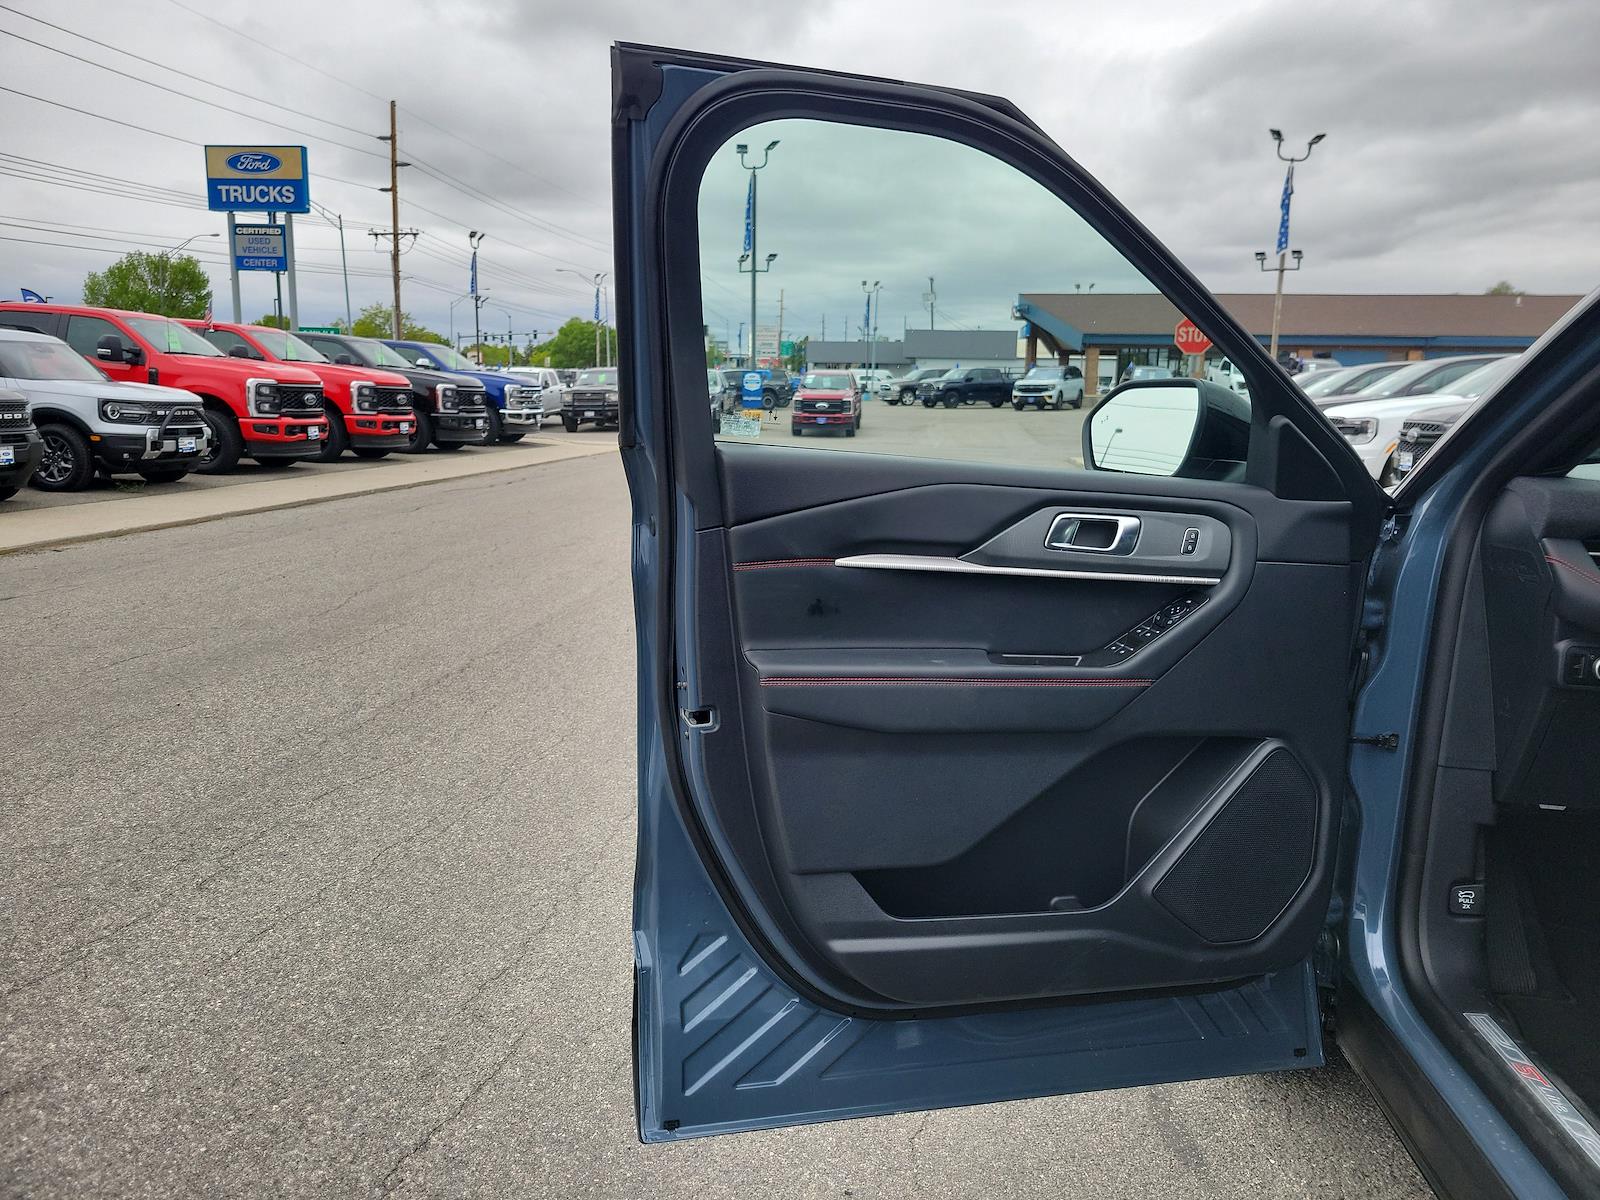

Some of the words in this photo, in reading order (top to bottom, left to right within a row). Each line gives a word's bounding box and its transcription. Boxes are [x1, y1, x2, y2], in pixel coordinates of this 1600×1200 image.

[237, 154, 271, 171] Ford
[217, 185, 295, 204] TRUCKS
[235, 226, 281, 235] CERTIFIED
[248, 237, 271, 245] USED
[242, 246, 278, 255] VEHICLE
[243, 258, 278, 267] CENTER
[1178, 326, 1209, 343] STO
